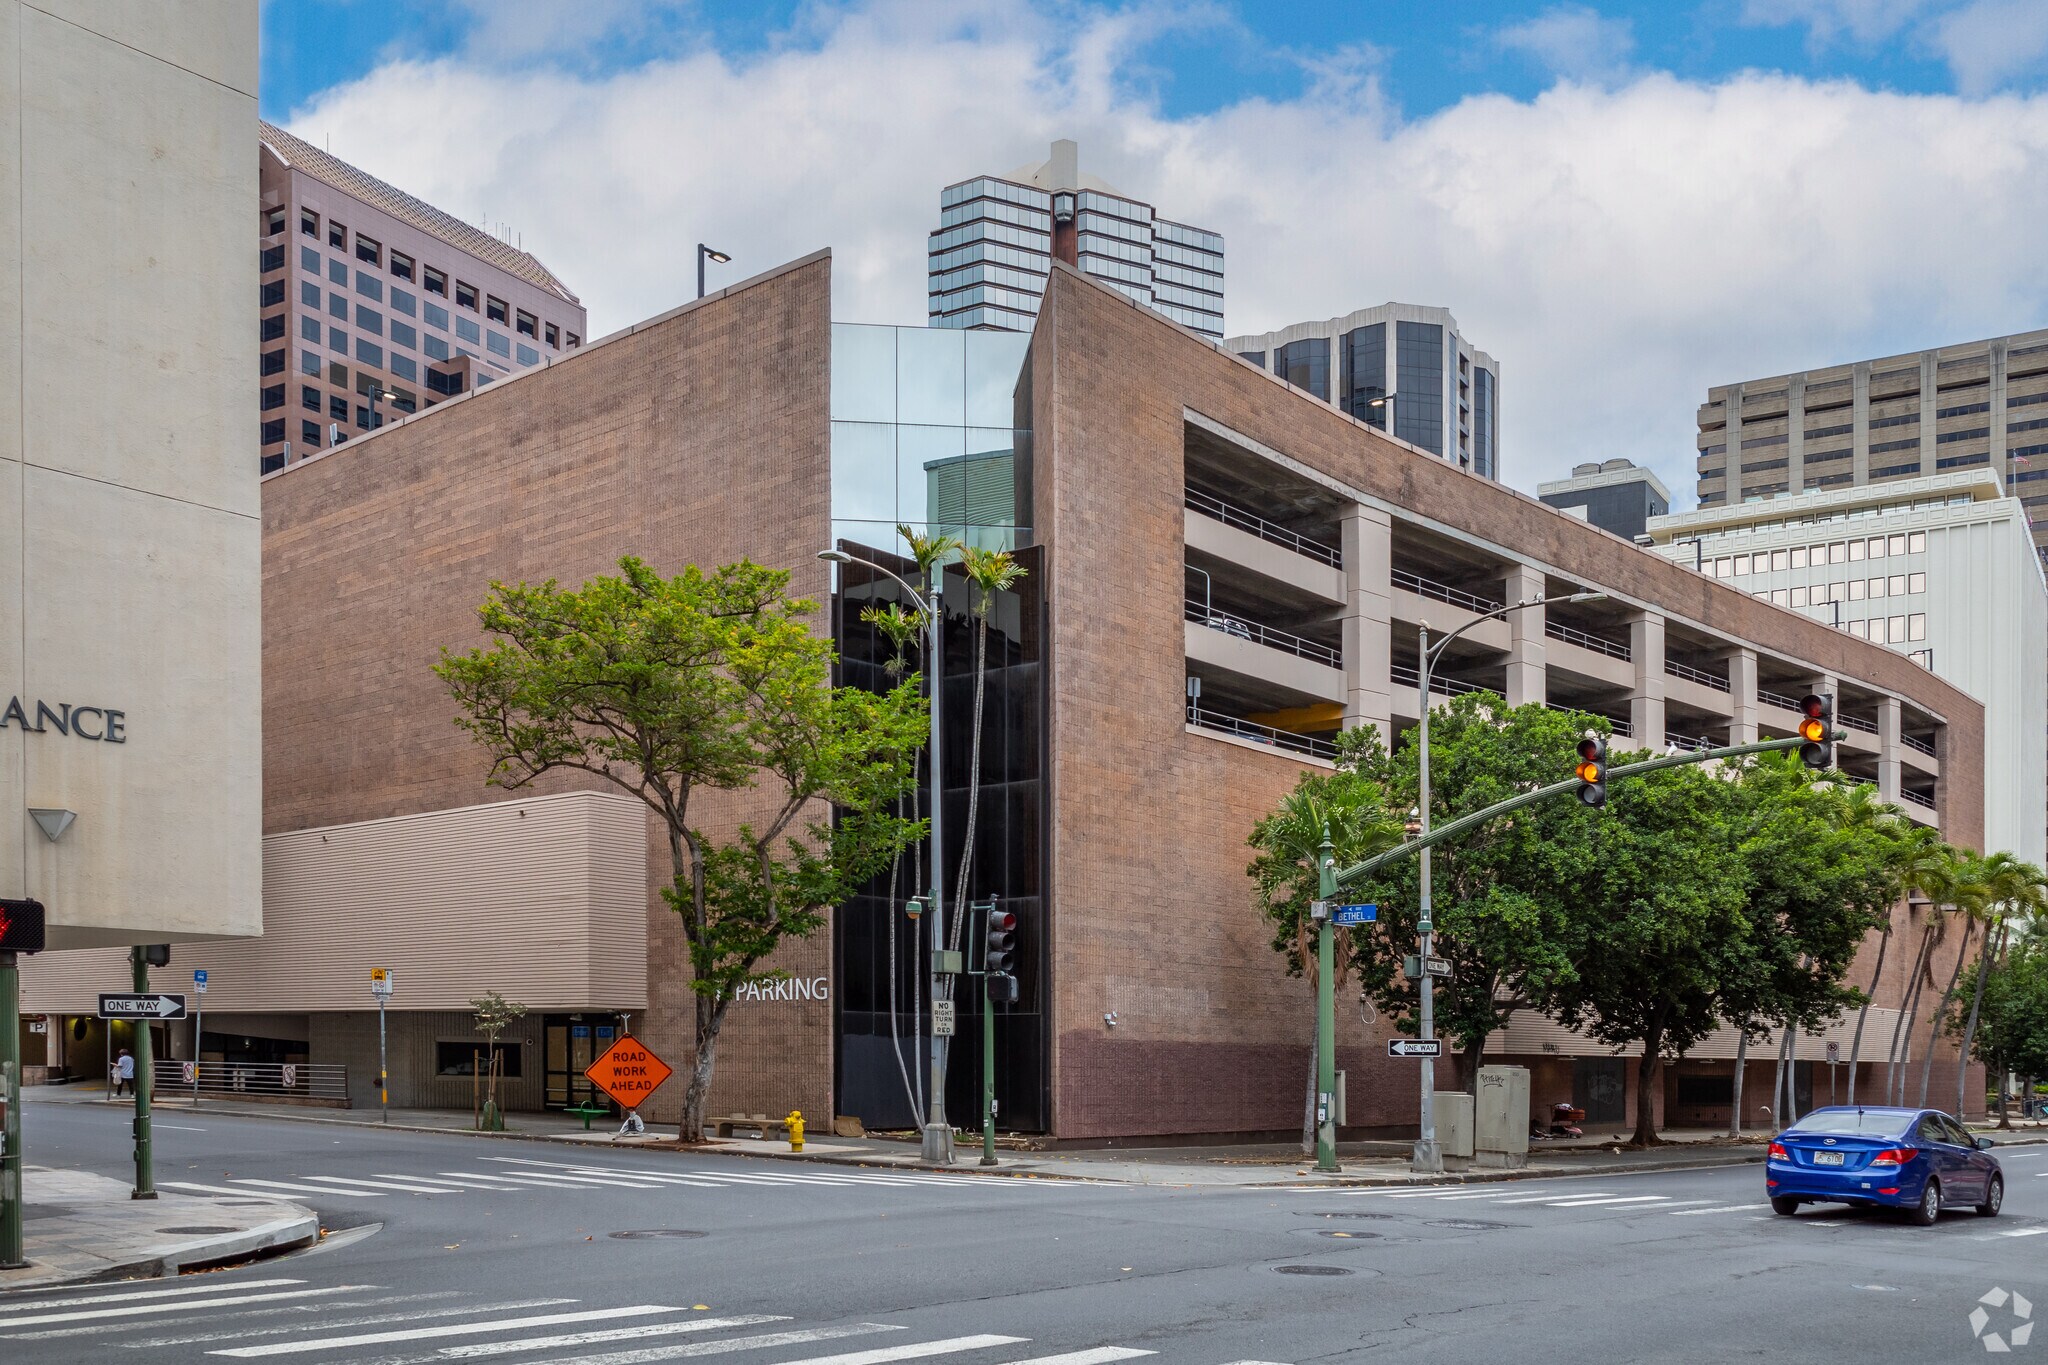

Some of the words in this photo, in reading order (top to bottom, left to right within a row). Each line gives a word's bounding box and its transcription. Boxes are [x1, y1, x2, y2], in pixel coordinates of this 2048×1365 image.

[0, 695, 126, 744] ANCE
[1338, 911, 1366, 921] BETHEL
[735, 977, 828, 1001] PARKING
[108, 1001, 131, 1011] ONE
[136, 1001, 160, 1011] WAY
[938, 1002, 949, 1010] NO
[1404, 1044, 1418, 1052] ONE
[1420, 1044, 1435, 1052] WAY
[613, 1052, 646, 1062] ROAD
[613, 1066, 647, 1076] WORK
[610, 1080, 652, 1091] AHEAD
